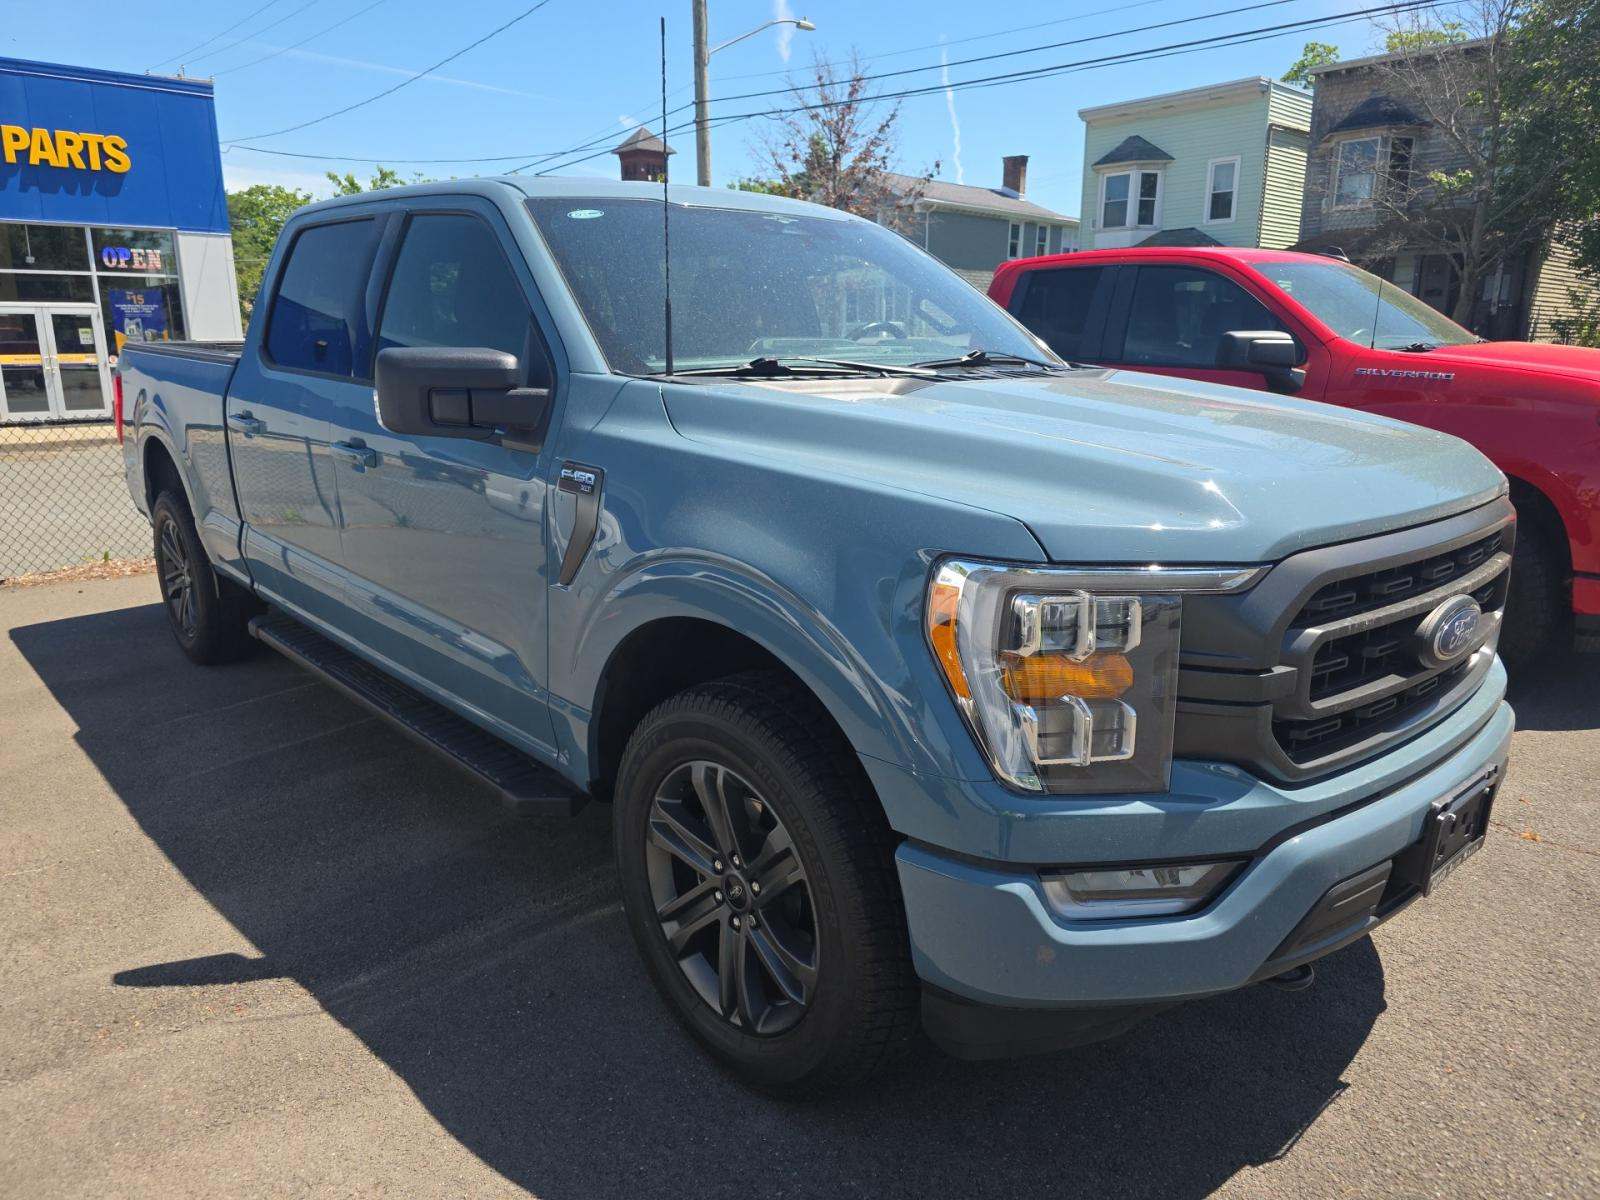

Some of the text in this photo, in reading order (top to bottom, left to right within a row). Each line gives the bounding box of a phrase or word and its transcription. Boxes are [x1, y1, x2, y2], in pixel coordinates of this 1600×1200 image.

[0, 124, 132, 174] PARTS
[102, 246, 162, 270] OPEN
[1354, 367, 1456, 381] SILVERADO
